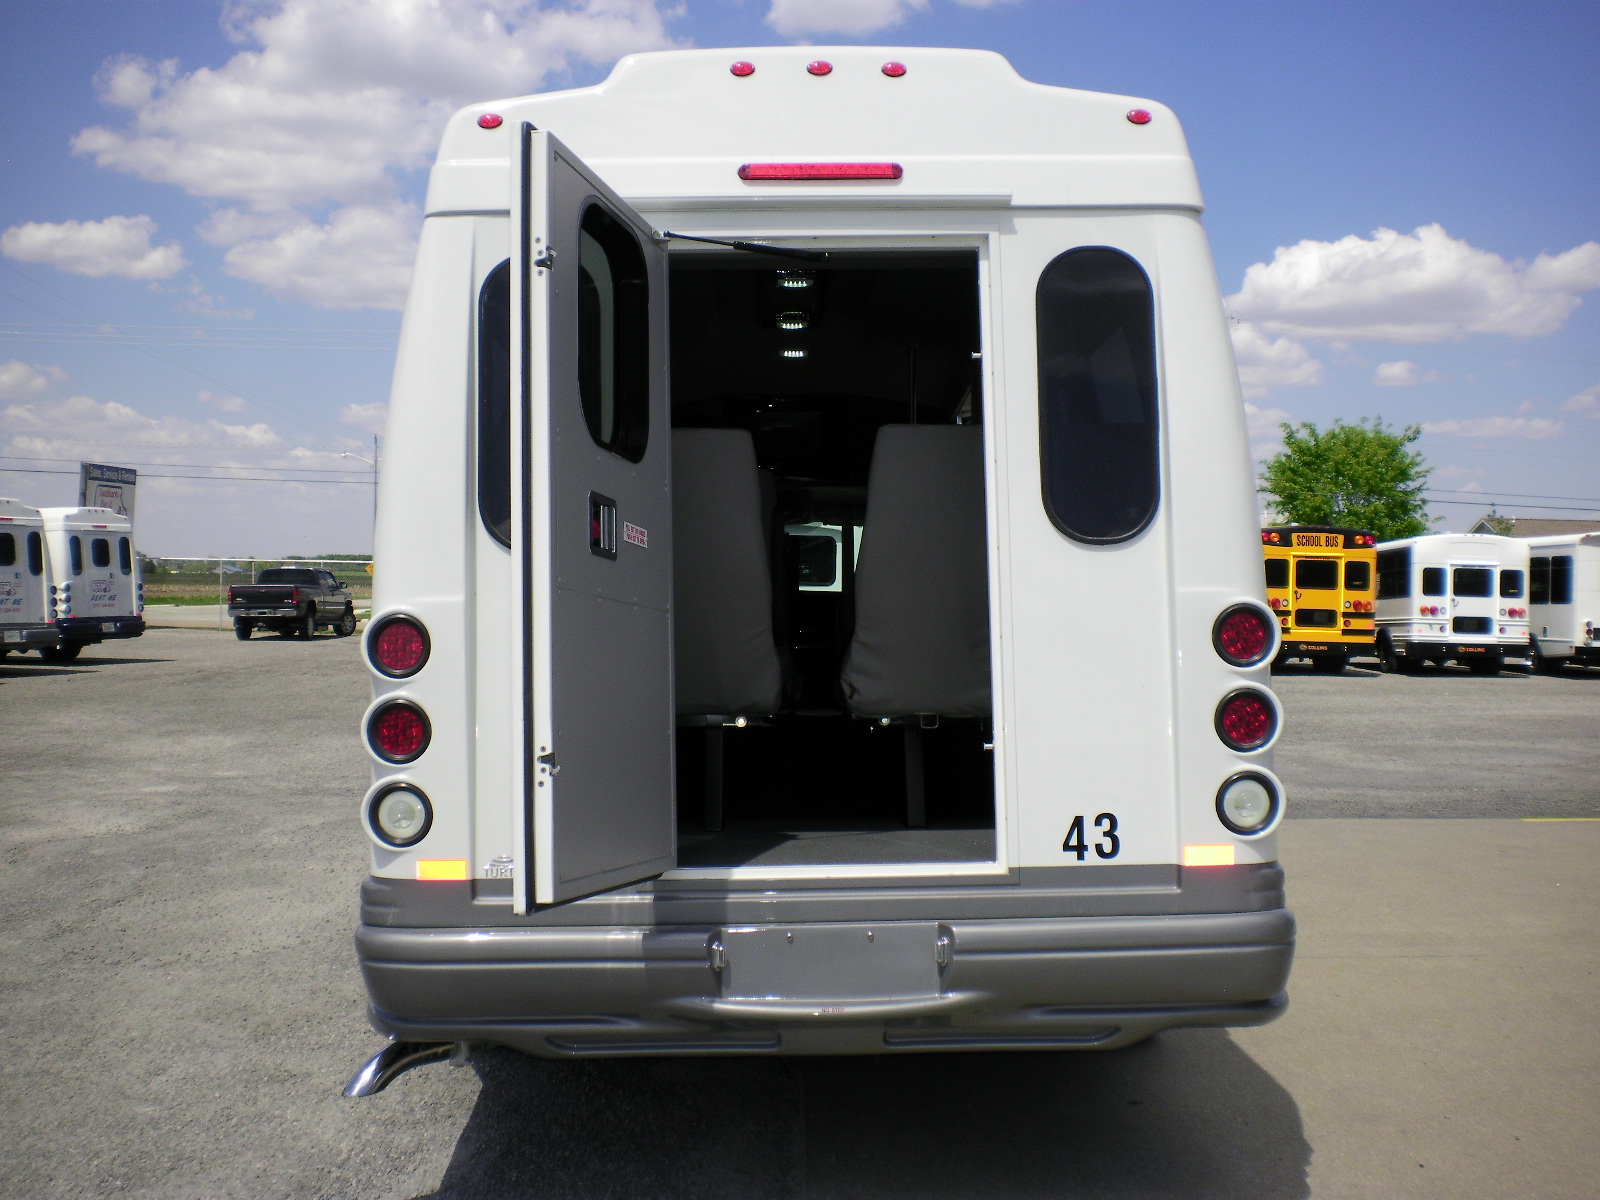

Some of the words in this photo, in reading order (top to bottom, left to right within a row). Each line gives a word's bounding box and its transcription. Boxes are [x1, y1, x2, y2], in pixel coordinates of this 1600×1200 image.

[1296, 535, 1322, 547] SCHOOL
[1325, 535, 1339, 547] BUS
[1062, 812, 1121, 861] 43
